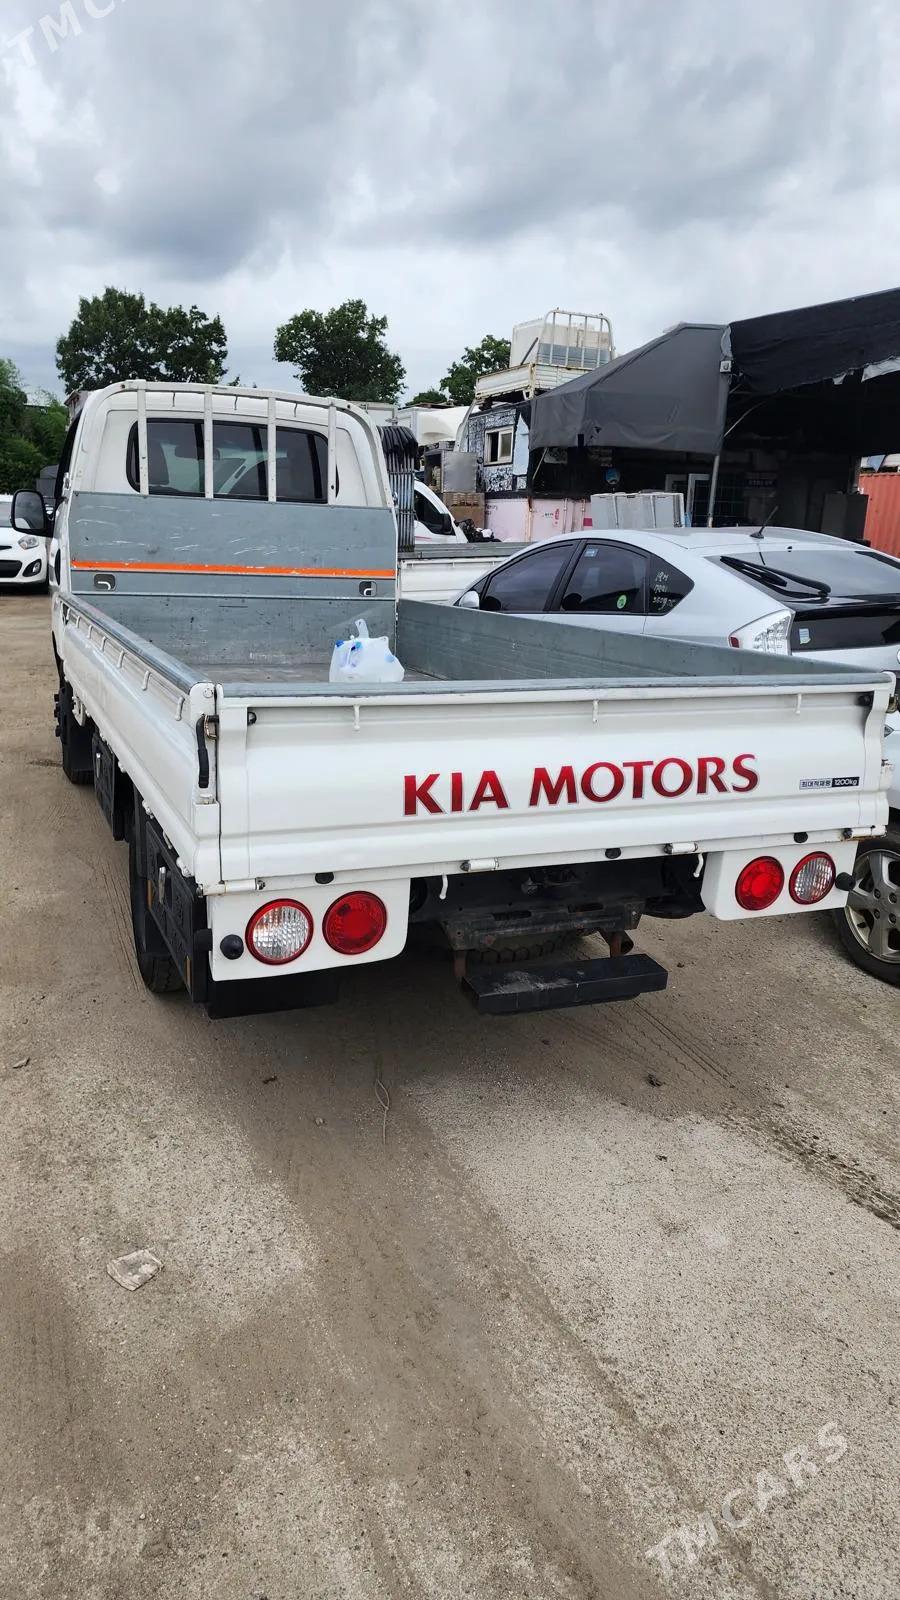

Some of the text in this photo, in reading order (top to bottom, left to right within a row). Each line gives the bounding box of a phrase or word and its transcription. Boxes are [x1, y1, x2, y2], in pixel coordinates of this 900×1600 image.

[403, 753, 759, 816] KIA MOTORS
[834, 778, 858, 786] 1200kg
